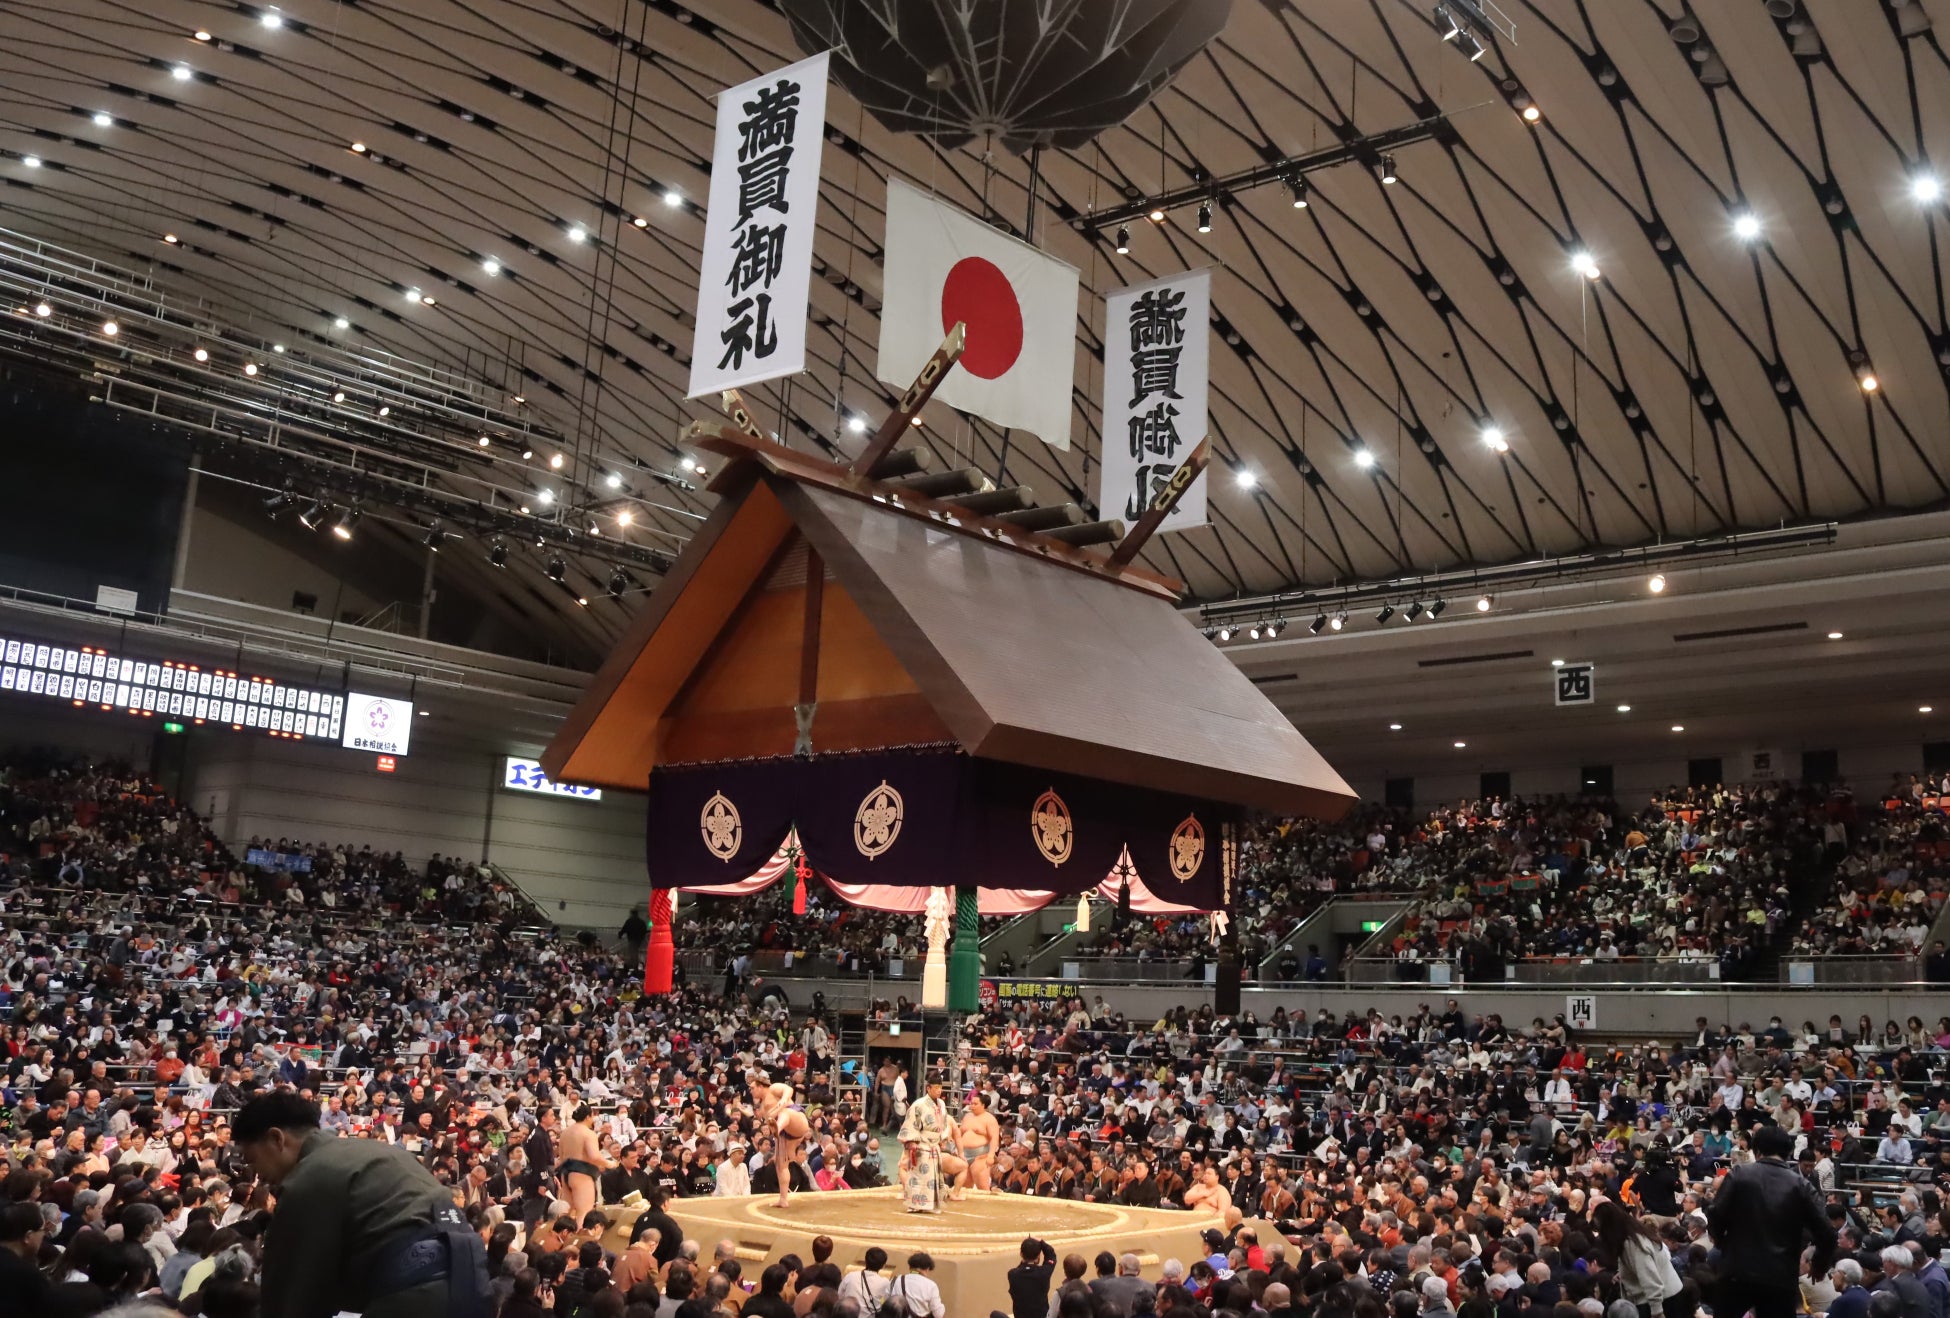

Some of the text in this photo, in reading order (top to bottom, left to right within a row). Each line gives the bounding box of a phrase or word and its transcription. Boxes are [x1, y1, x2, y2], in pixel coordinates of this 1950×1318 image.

[717, 79, 801, 371] 満員御礼
[1558, 666, 1592, 701] 西
[354, 738, 397, 752] 日本相撲協会
[1572, 998, 1591, 1021] 西
[1578, 1020, 1585, 1029] W
